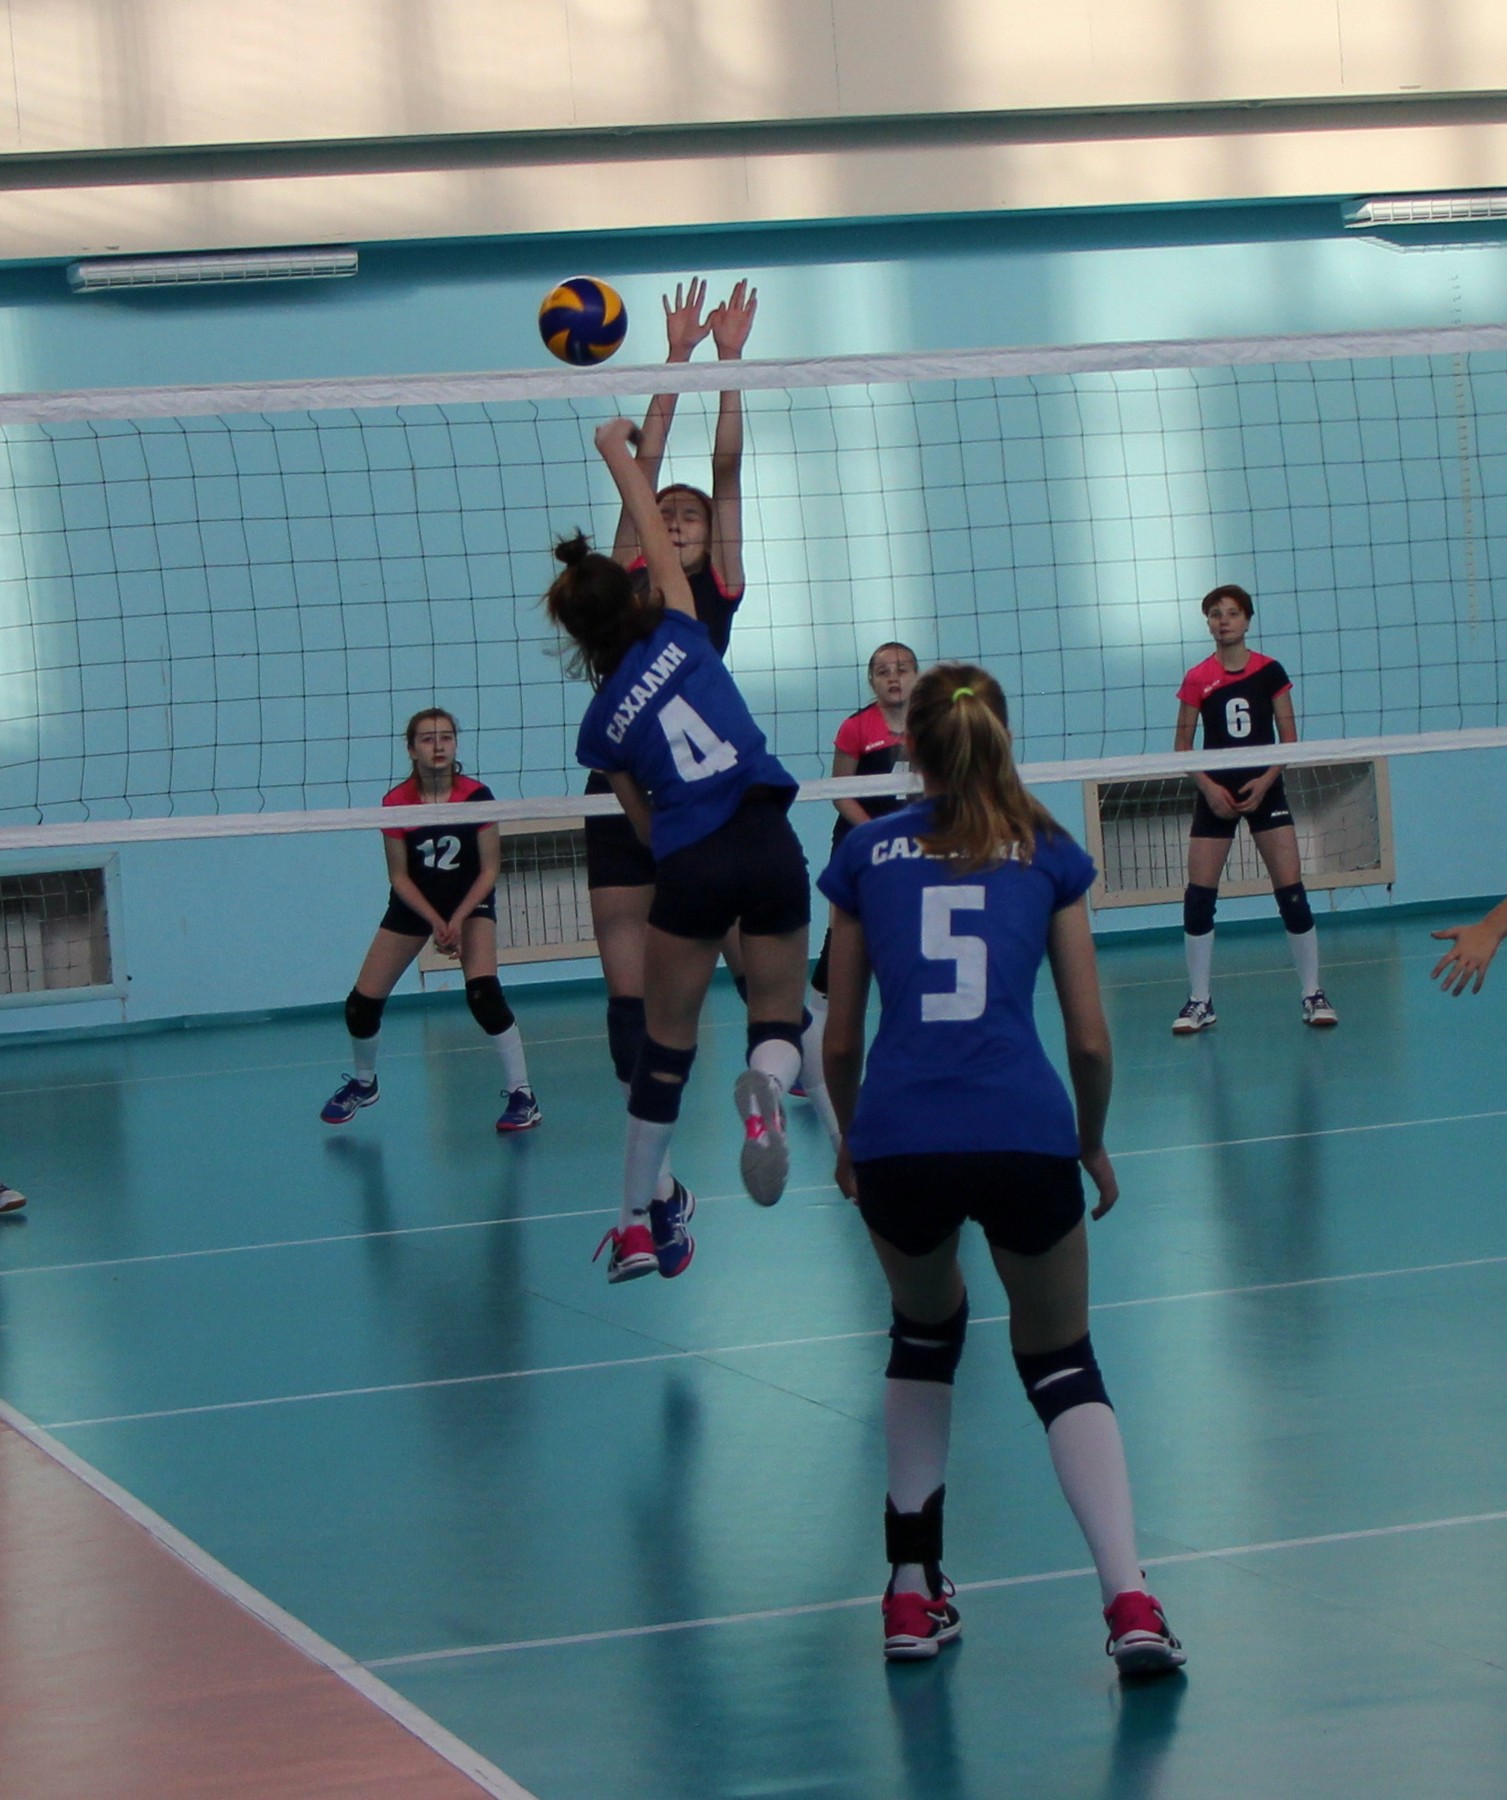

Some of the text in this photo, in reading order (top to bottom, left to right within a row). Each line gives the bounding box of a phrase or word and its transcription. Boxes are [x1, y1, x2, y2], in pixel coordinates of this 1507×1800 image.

[606, 641, 688, 744] САХАЛИН
[1225, 697, 1252, 738] 6
[657, 694, 738, 782] 4
[416, 835, 461, 871] 12
[921, 885, 987, 1022] 5
